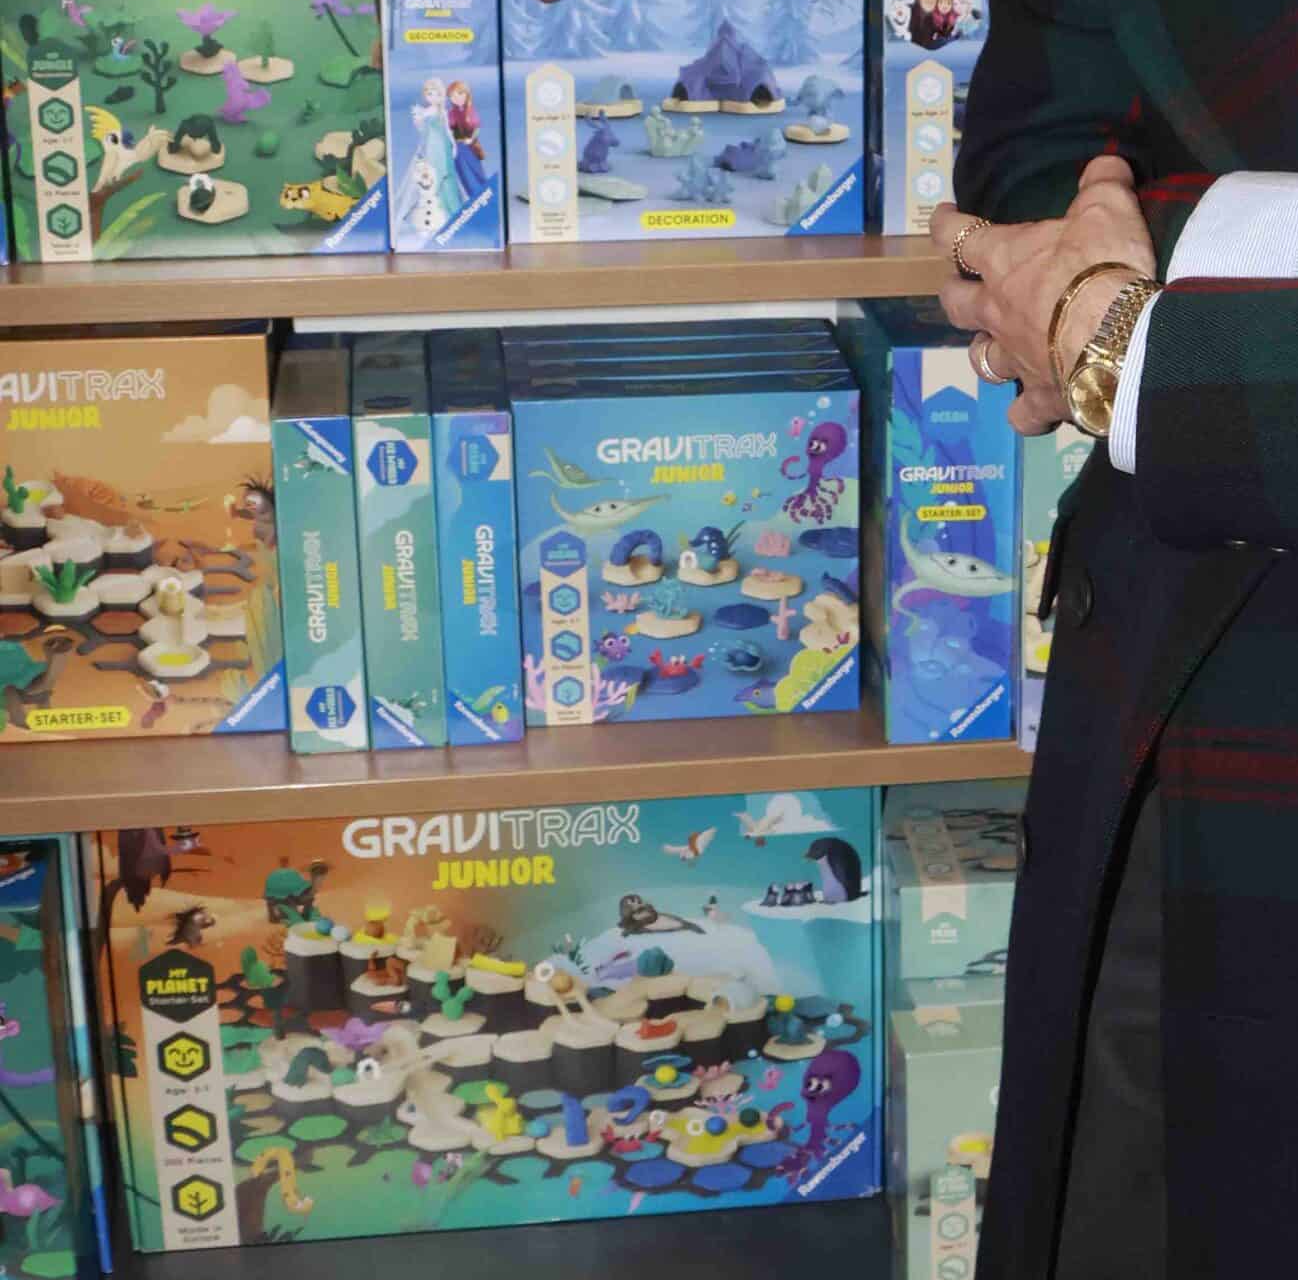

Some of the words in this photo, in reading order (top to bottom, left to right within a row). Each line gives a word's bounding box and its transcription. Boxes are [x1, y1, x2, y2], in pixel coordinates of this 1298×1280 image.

[800, 173, 858, 231] Ravensburger
[326, 190, 385, 250] Ravensburger
[434, 188, 494, 248] Ravensburger
[647, 213, 730, 227] DECORATION
[7, 405, 101, 430] JUNIOR
[597, 431, 777, 463] GRAVITRAX
[650, 463, 725, 484] JUNIOR
[899, 464, 1005, 482] GRAVITRAX
[929, 482, 974, 494] JUNIOR
[475, 524, 498, 636] GRAVITRAX
[802, 656, 855, 709] Ravensburger
[34, 711, 124, 726] STARTER-SET
[342, 804, 640, 859] GRAVITRAX
[432, 854, 554, 891] JUNIOR
[147, 978, 208, 995] PLANET
[168, 969, 188, 978] MY
